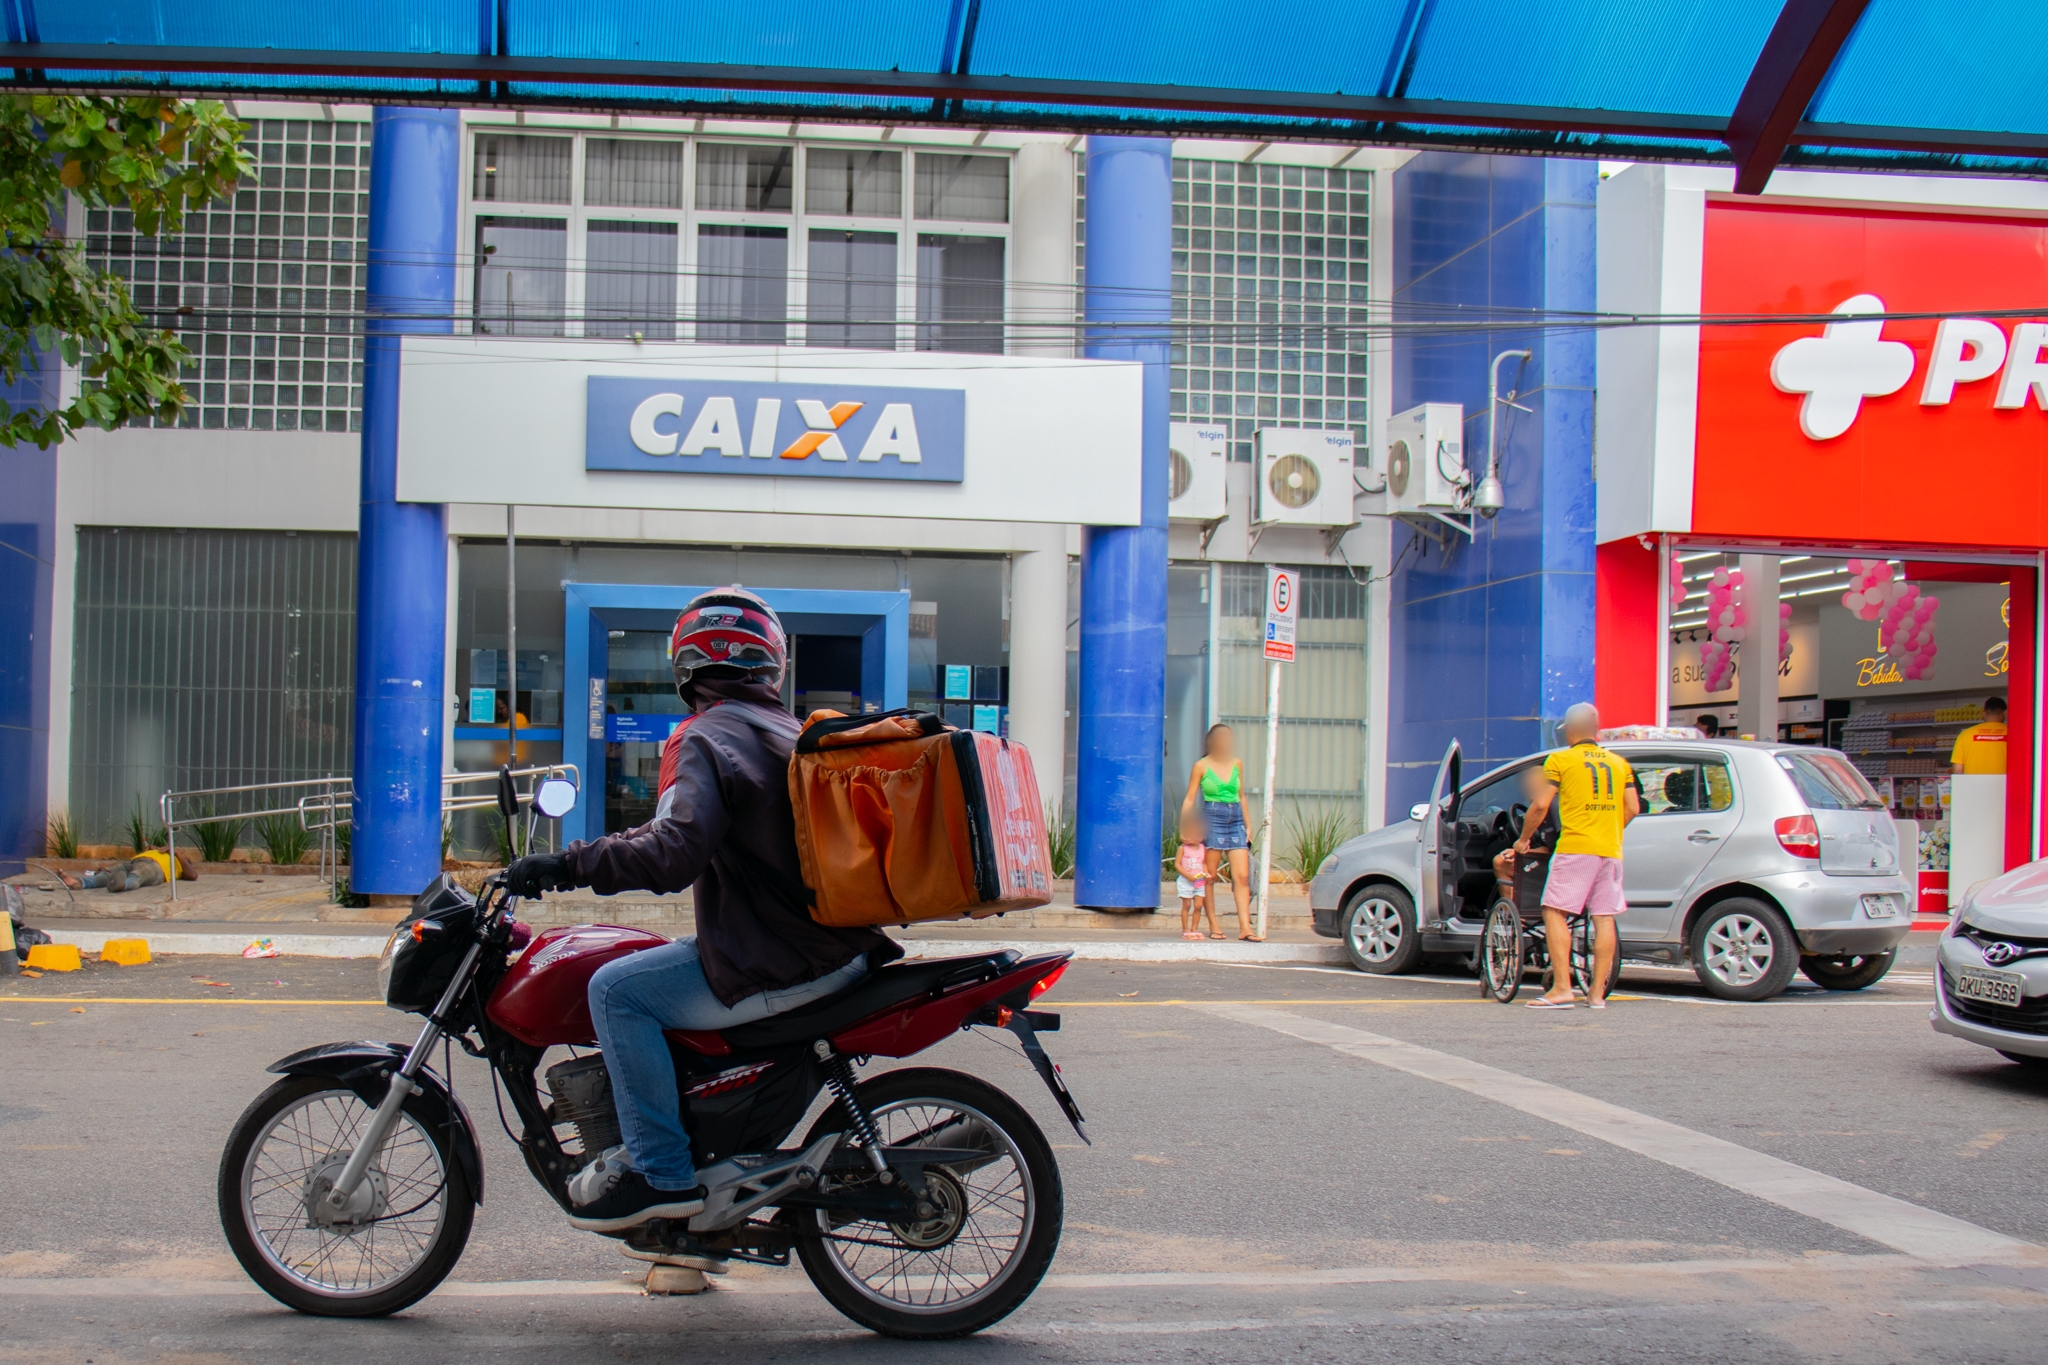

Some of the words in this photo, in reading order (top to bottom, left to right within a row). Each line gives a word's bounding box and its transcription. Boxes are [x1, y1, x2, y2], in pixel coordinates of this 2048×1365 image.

[630, 393, 923, 464] CAIXA
[1198, 431, 1225, 441] elgin
[1326, 437, 1353, 447] elgin
[1279, 582, 1287, 605] E
[1269, 612, 1293, 624] EXCLUSIVO
[1672, 667, 1681, 684] a
[1584, 762, 1613, 800] 11
[531, 951, 577, 974] HONDA
[691, 1063, 775, 1092] START
